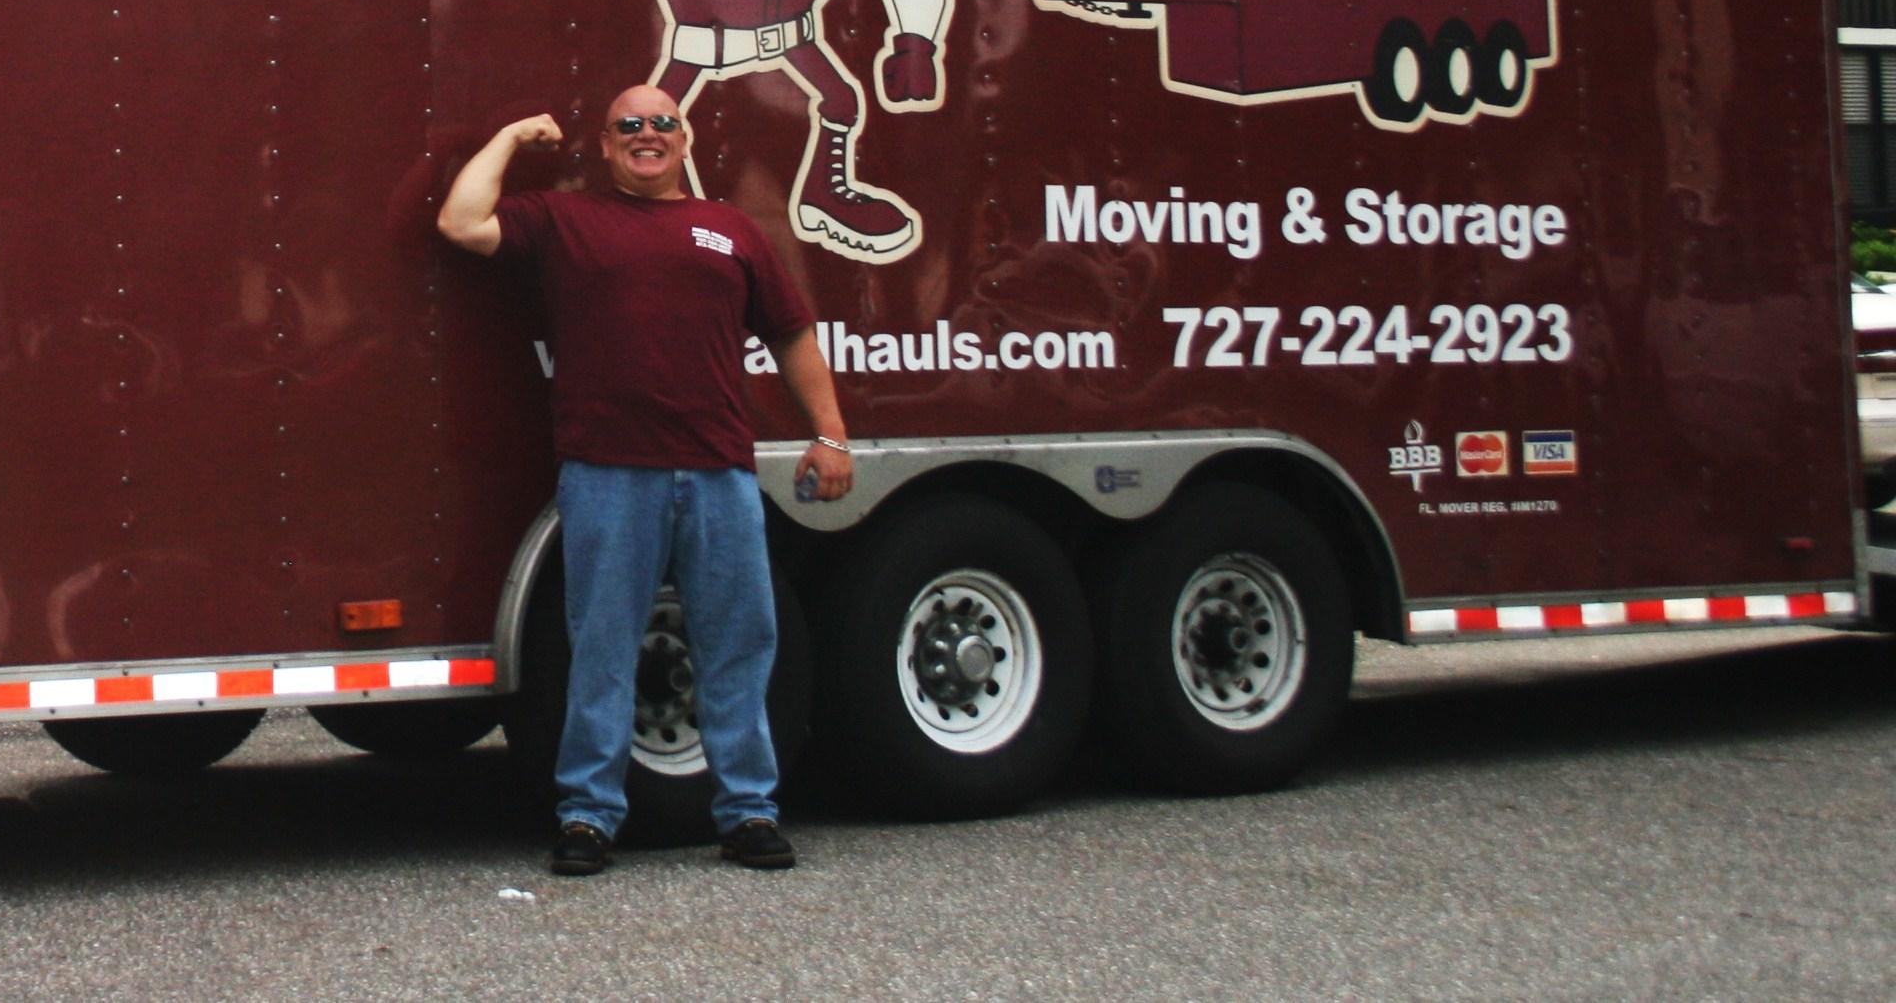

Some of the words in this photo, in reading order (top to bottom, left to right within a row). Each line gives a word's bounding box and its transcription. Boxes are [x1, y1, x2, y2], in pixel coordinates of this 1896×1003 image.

[1044, 184, 1262, 259] Moving
[1281, 187, 1328, 245] &
[1344, 188, 1567, 259] Storage
[1162, 304, 1572, 368] 727-224-2923
[1389, 445, 1442, 470] BBB
[1532, 444, 1566, 460] VISA
[1439, 502, 1479, 514] MOVER
[1481, 501, 1508, 513] REG.
